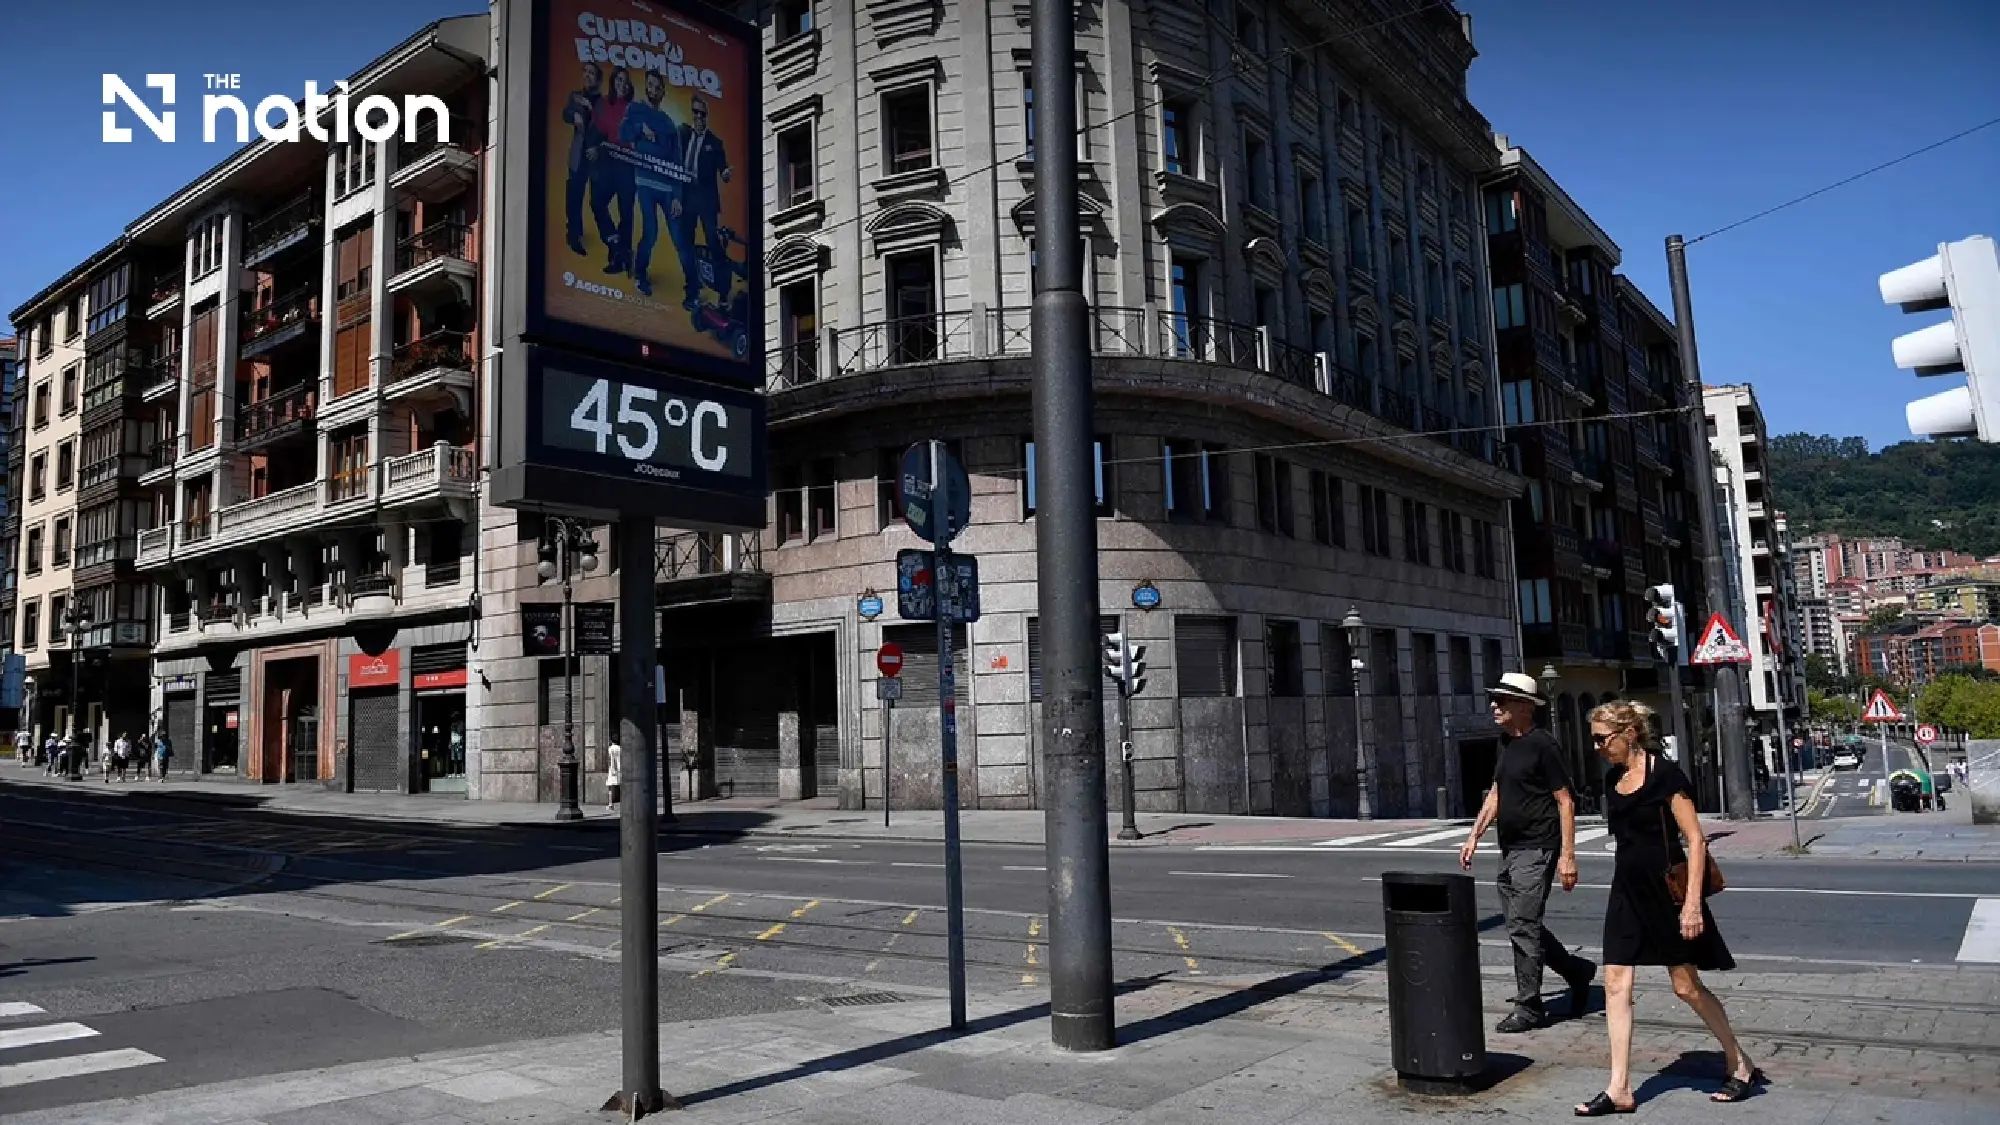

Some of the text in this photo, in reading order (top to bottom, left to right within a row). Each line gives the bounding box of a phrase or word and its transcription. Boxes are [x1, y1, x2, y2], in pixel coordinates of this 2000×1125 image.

[575, 38, 723, 98] ESCOMBRO
[563, 271, 575, 287] 9
[575, 279, 623, 300] AGOSTO
